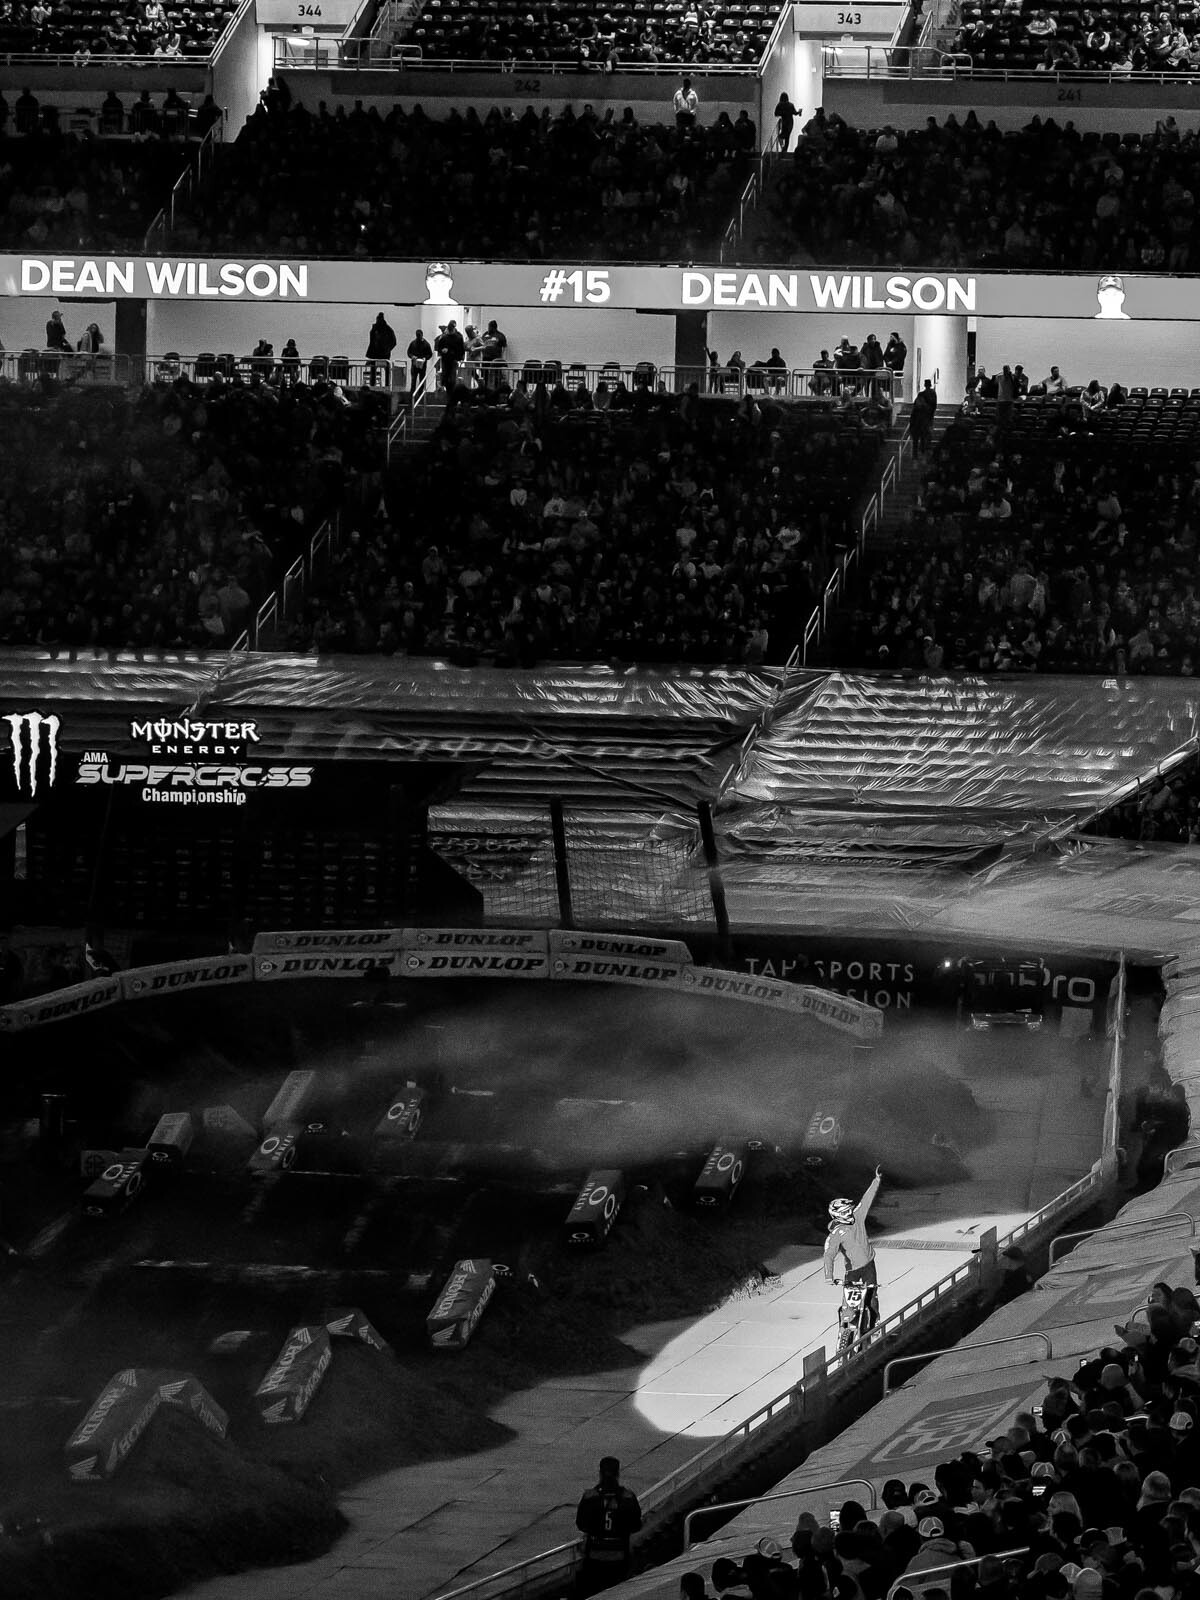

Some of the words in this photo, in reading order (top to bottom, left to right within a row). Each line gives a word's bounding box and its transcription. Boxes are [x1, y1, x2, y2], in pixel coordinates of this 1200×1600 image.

[297, 5, 322, 17] 344
[836, 12, 862, 25] 343
[514, 79, 540, 94] 242
[1057, 88, 1083, 103] 241
[20, 259, 135, 294] DEAN
[144, 261, 309, 299] WILSON
[538, 268, 612, 306] #15
[680, 272, 799, 308] DEAN
[809, 274, 977, 312] WILSON
[82, 752, 109, 763] AMA
[151, 745, 241, 755] ENERGY
[75, 764, 314, 787] SUPERCROSS
[141, 788, 247, 806] Championship
[294, 933, 392, 948] DUNLOP
[433, 932, 534, 947] DUNLOP
[580, 938, 667, 957] DUNLOP
[281, 955, 395, 974] DUNLOP
[427, 956, 546, 972] DUNLOP
[573, 961, 678, 982] DUNLOP
[151, 964, 248, 991] DUNLOP
[700, 975, 783, 1002] DUNLOP
[37, 986, 119, 1022] DUNLOP
[801, 995, 862, 1026] DUNLOP
[846, 1290, 863, 1302] 15
